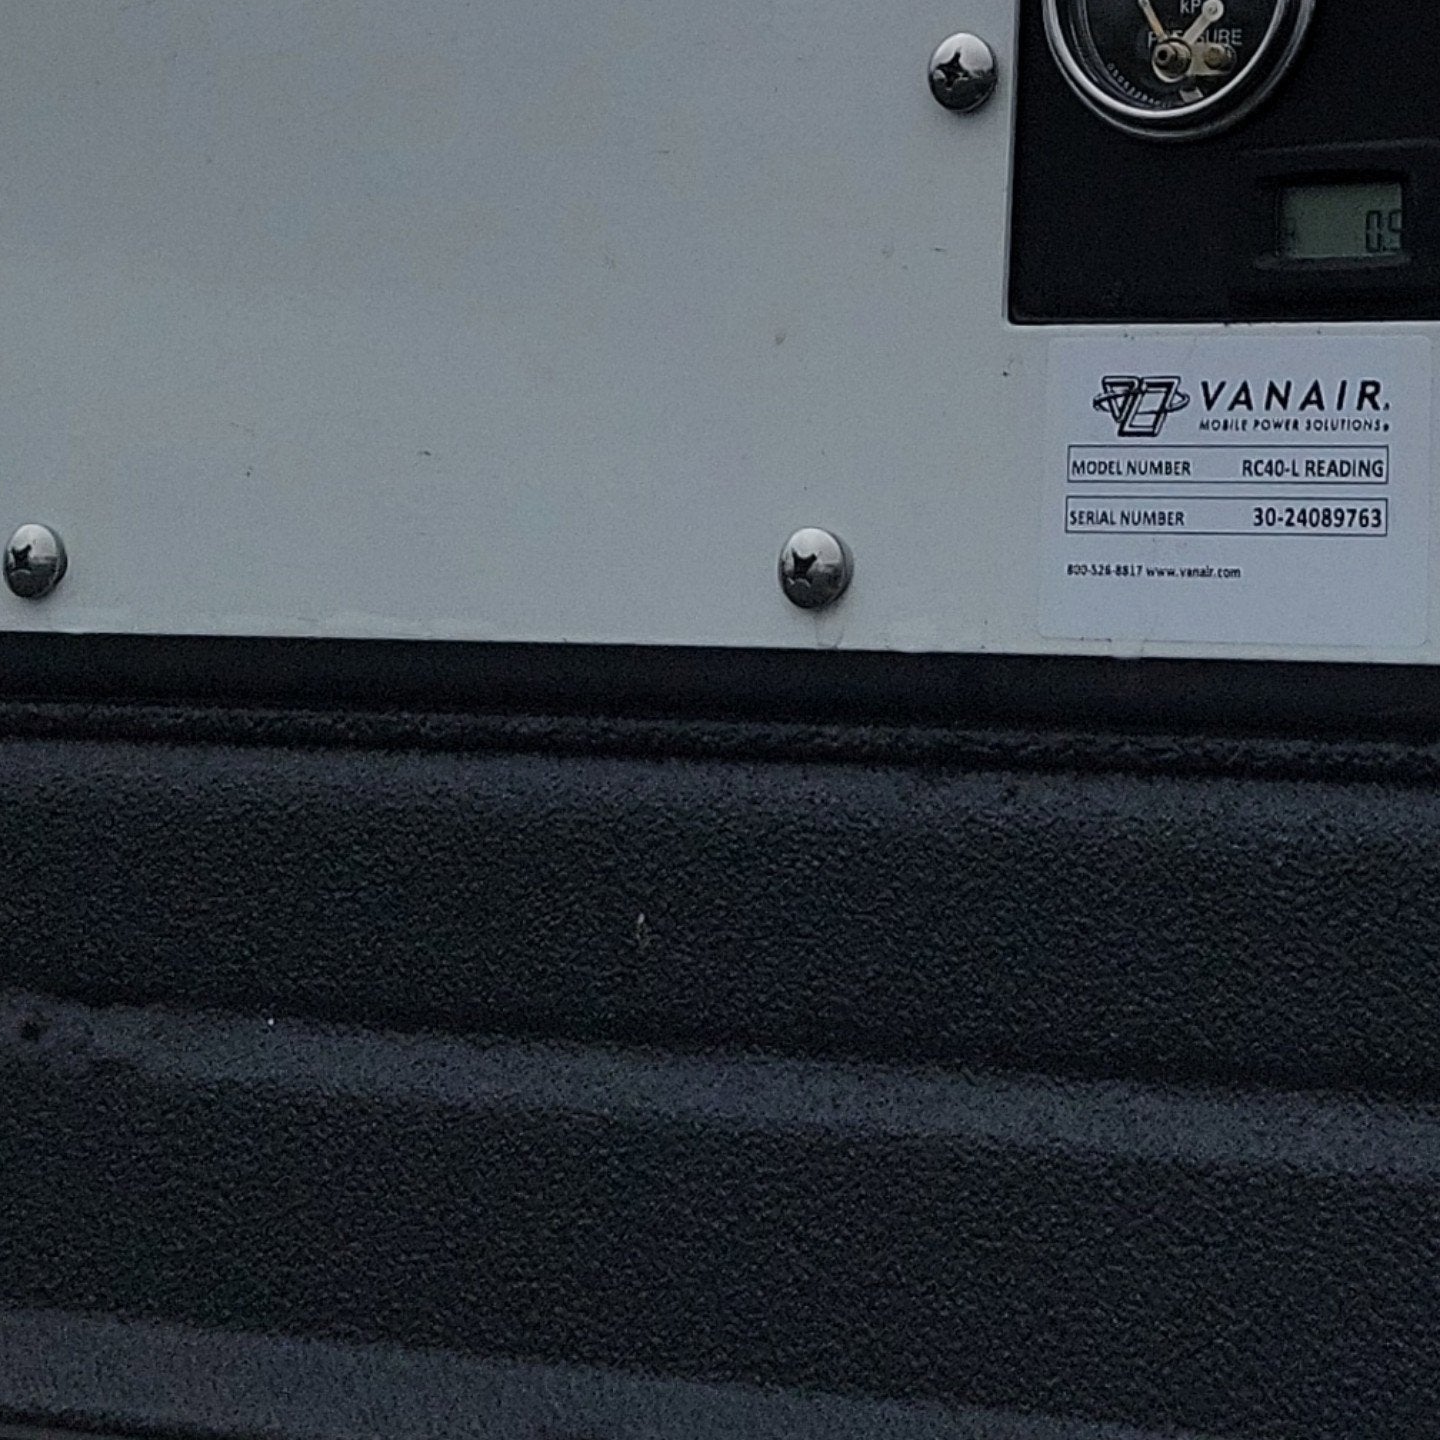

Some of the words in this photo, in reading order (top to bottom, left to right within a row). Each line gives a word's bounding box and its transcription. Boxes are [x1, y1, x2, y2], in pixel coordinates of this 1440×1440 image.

[1199, 419, 1248, 432] MOBILE
[1253, 419, 1300, 432] POWER
[1071, 459, 1124, 476] MODEL
[1126, 460, 1191, 477] NUMBER
[1242, 459, 1300, 477] RC40-L
[1304, 459, 1385, 478] READING
[1069, 509, 1116, 526] SERIAL
[1120, 509, 1185, 526] NUMBER
[1253, 507, 1383, 528] 30-24089763
[1145, 565, 1241, 578] www.vanair.com
